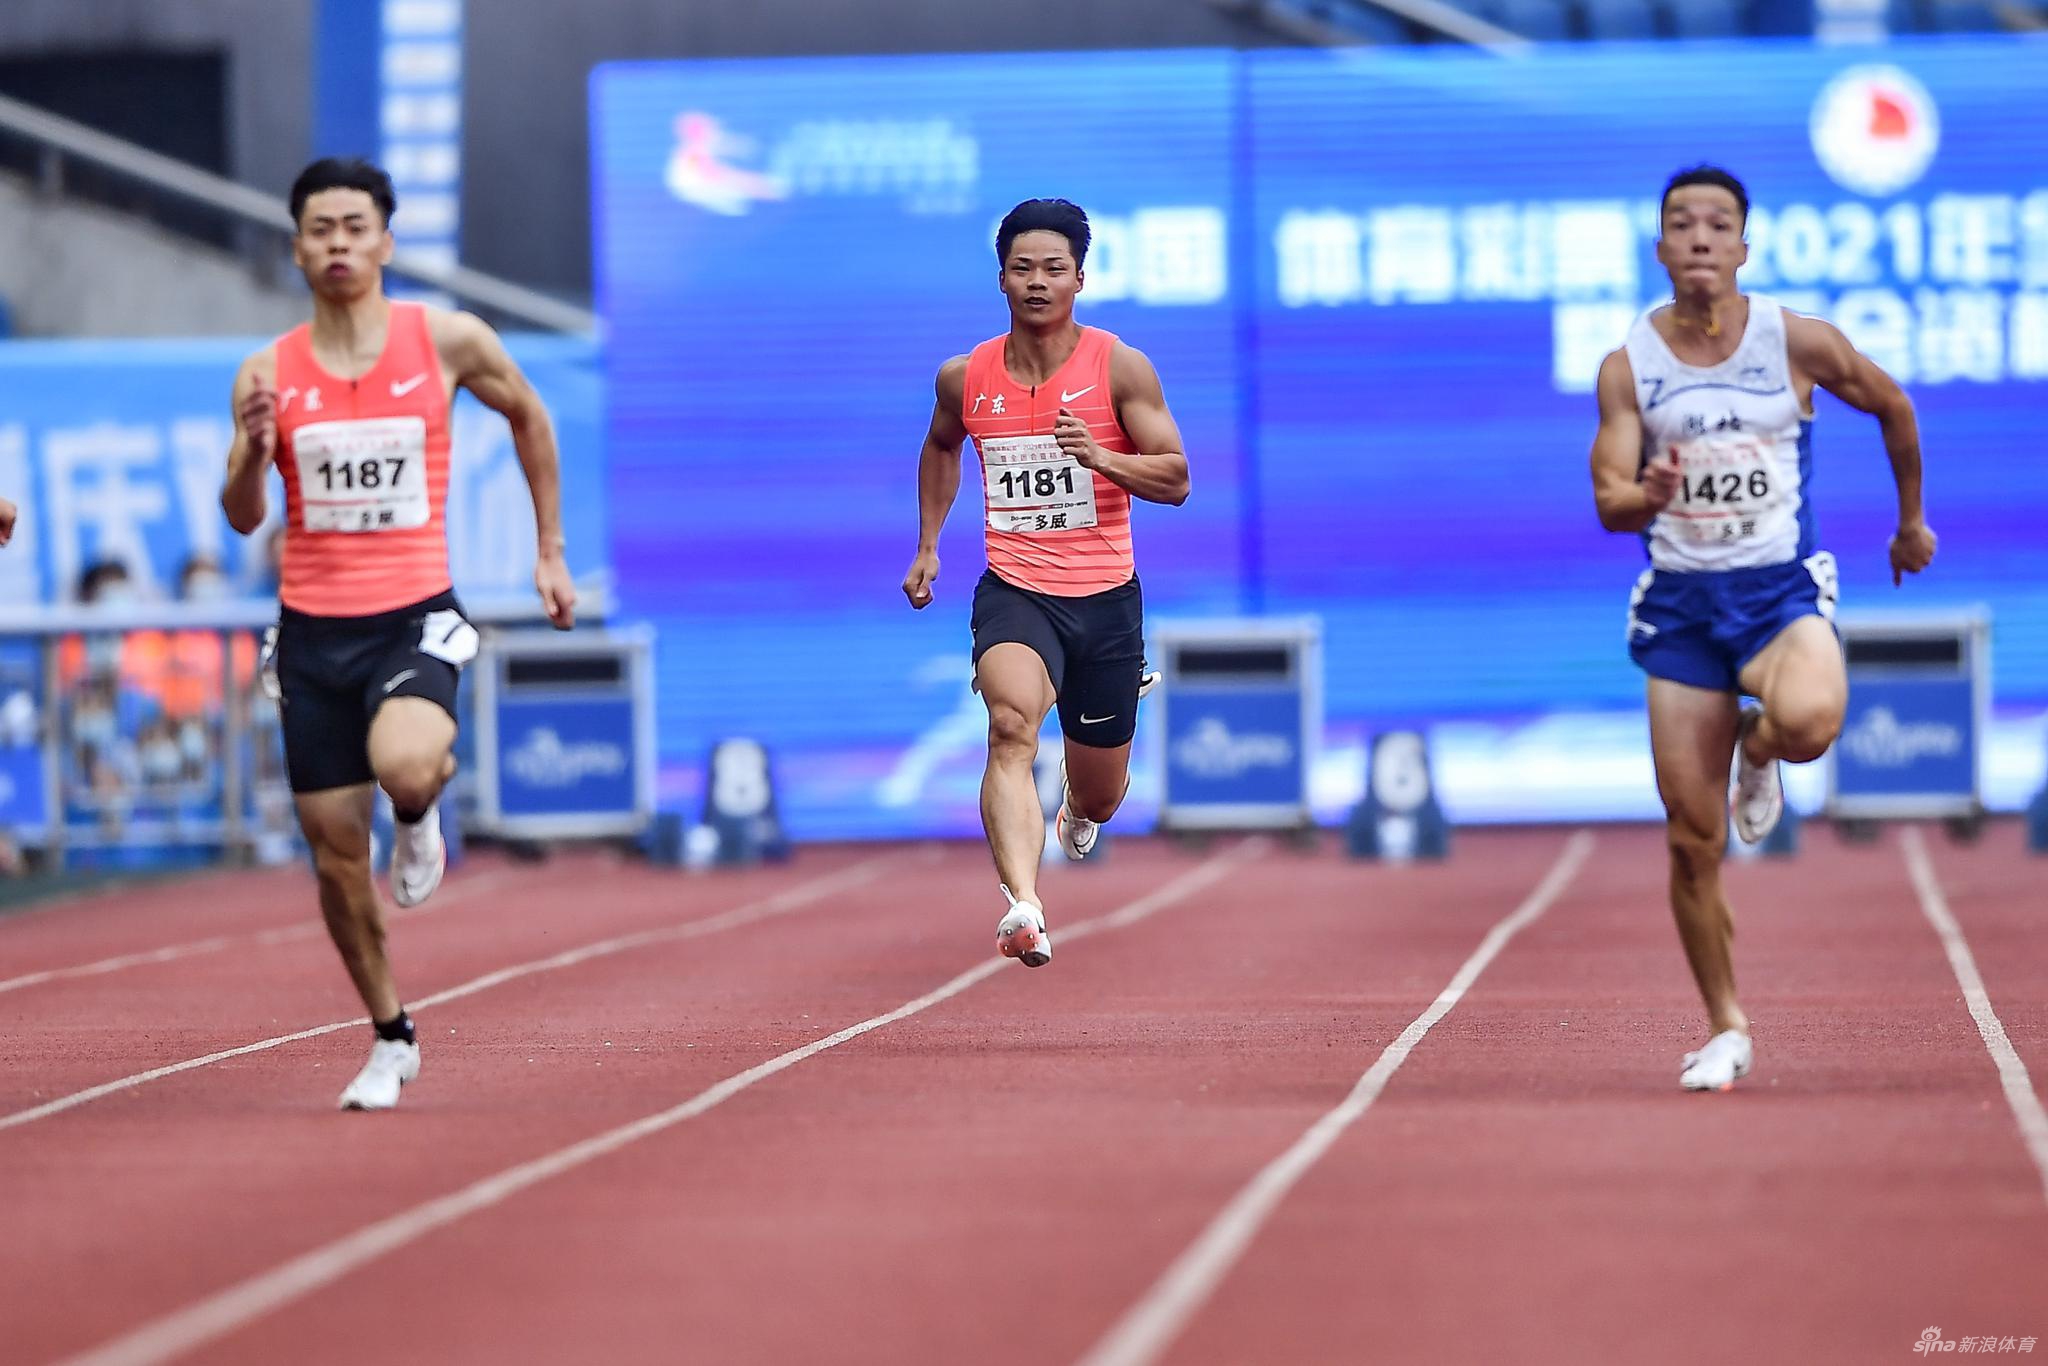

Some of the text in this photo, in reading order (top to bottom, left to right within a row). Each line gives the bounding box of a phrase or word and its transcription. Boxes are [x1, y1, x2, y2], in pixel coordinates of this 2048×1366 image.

[972, 393, 1006, 414] 广东
[318, 458, 407, 490] 1187
[1000, 466, 1075, 498] 1181
[1681, 469, 1768, 504] 1426
[1035, 512, 1067, 530] 多威
[713, 737, 771, 817] 8
[1373, 731, 1430, 811] 6
